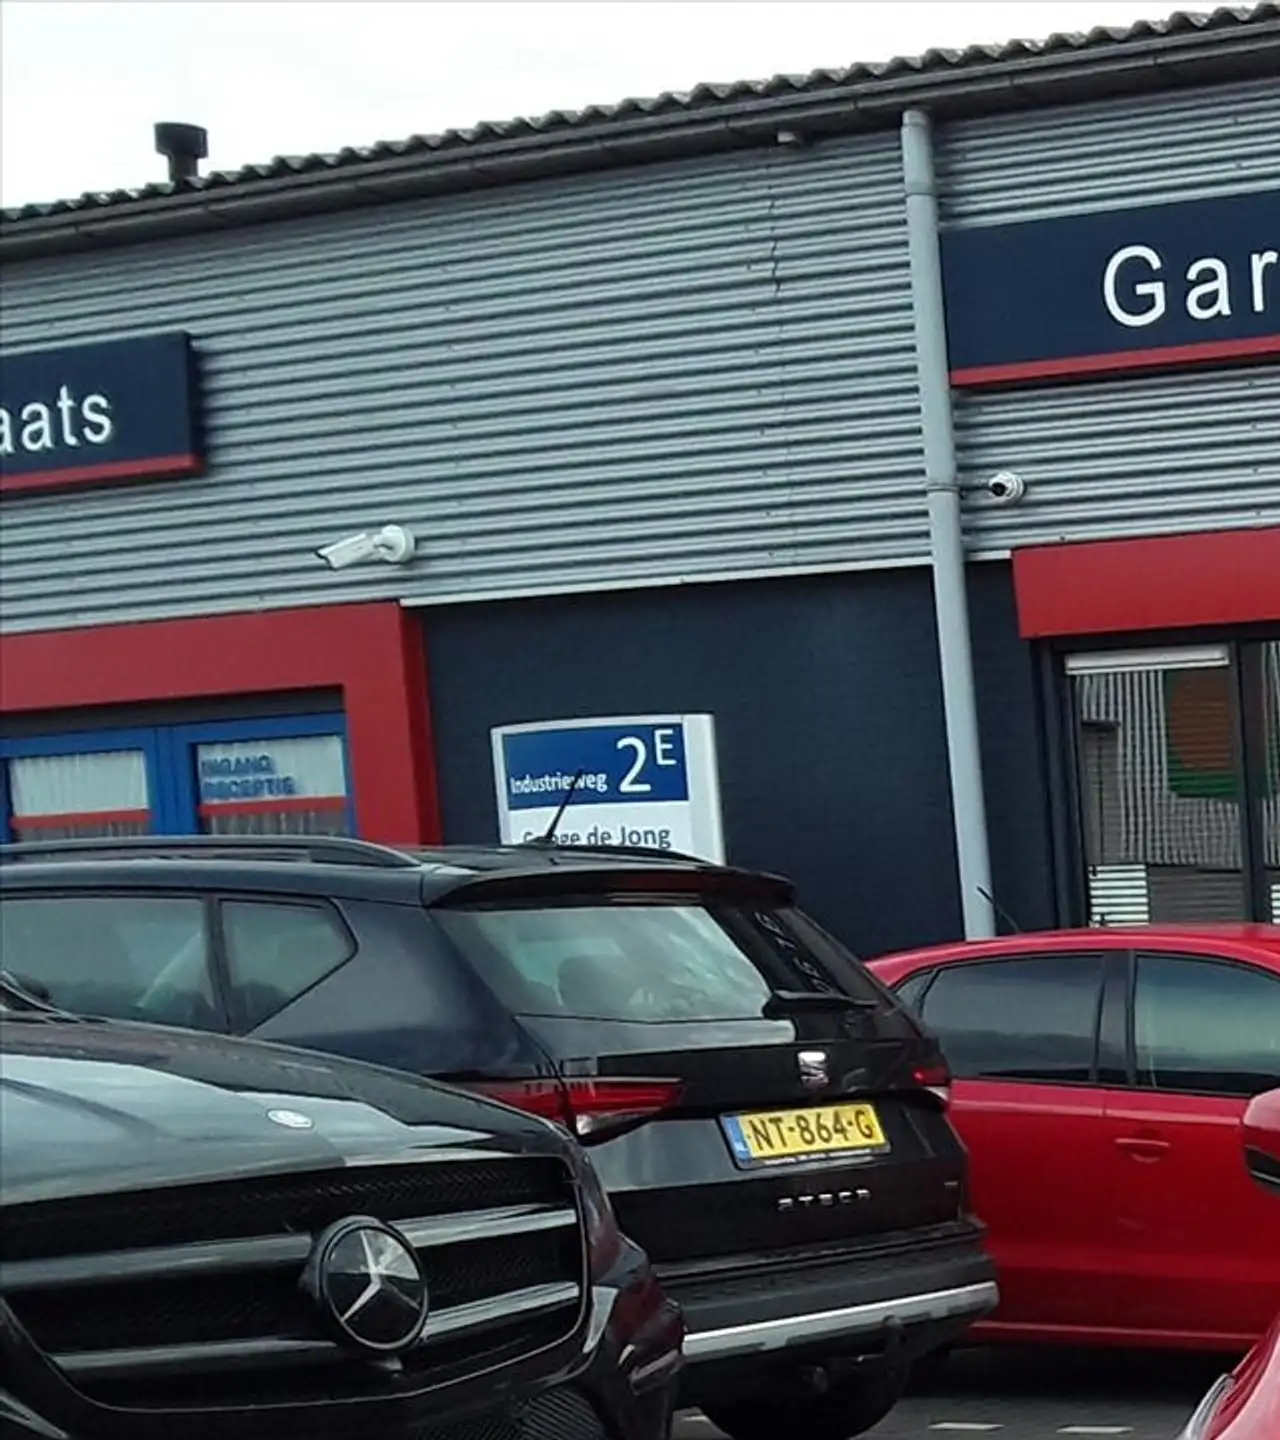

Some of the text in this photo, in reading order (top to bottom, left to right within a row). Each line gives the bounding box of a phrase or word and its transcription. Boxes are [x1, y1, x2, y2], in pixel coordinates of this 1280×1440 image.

[587, 825, 612, 846] de
[619, 825, 672, 849] Jong
[748, 1109, 874, 1151] NT-864-G
